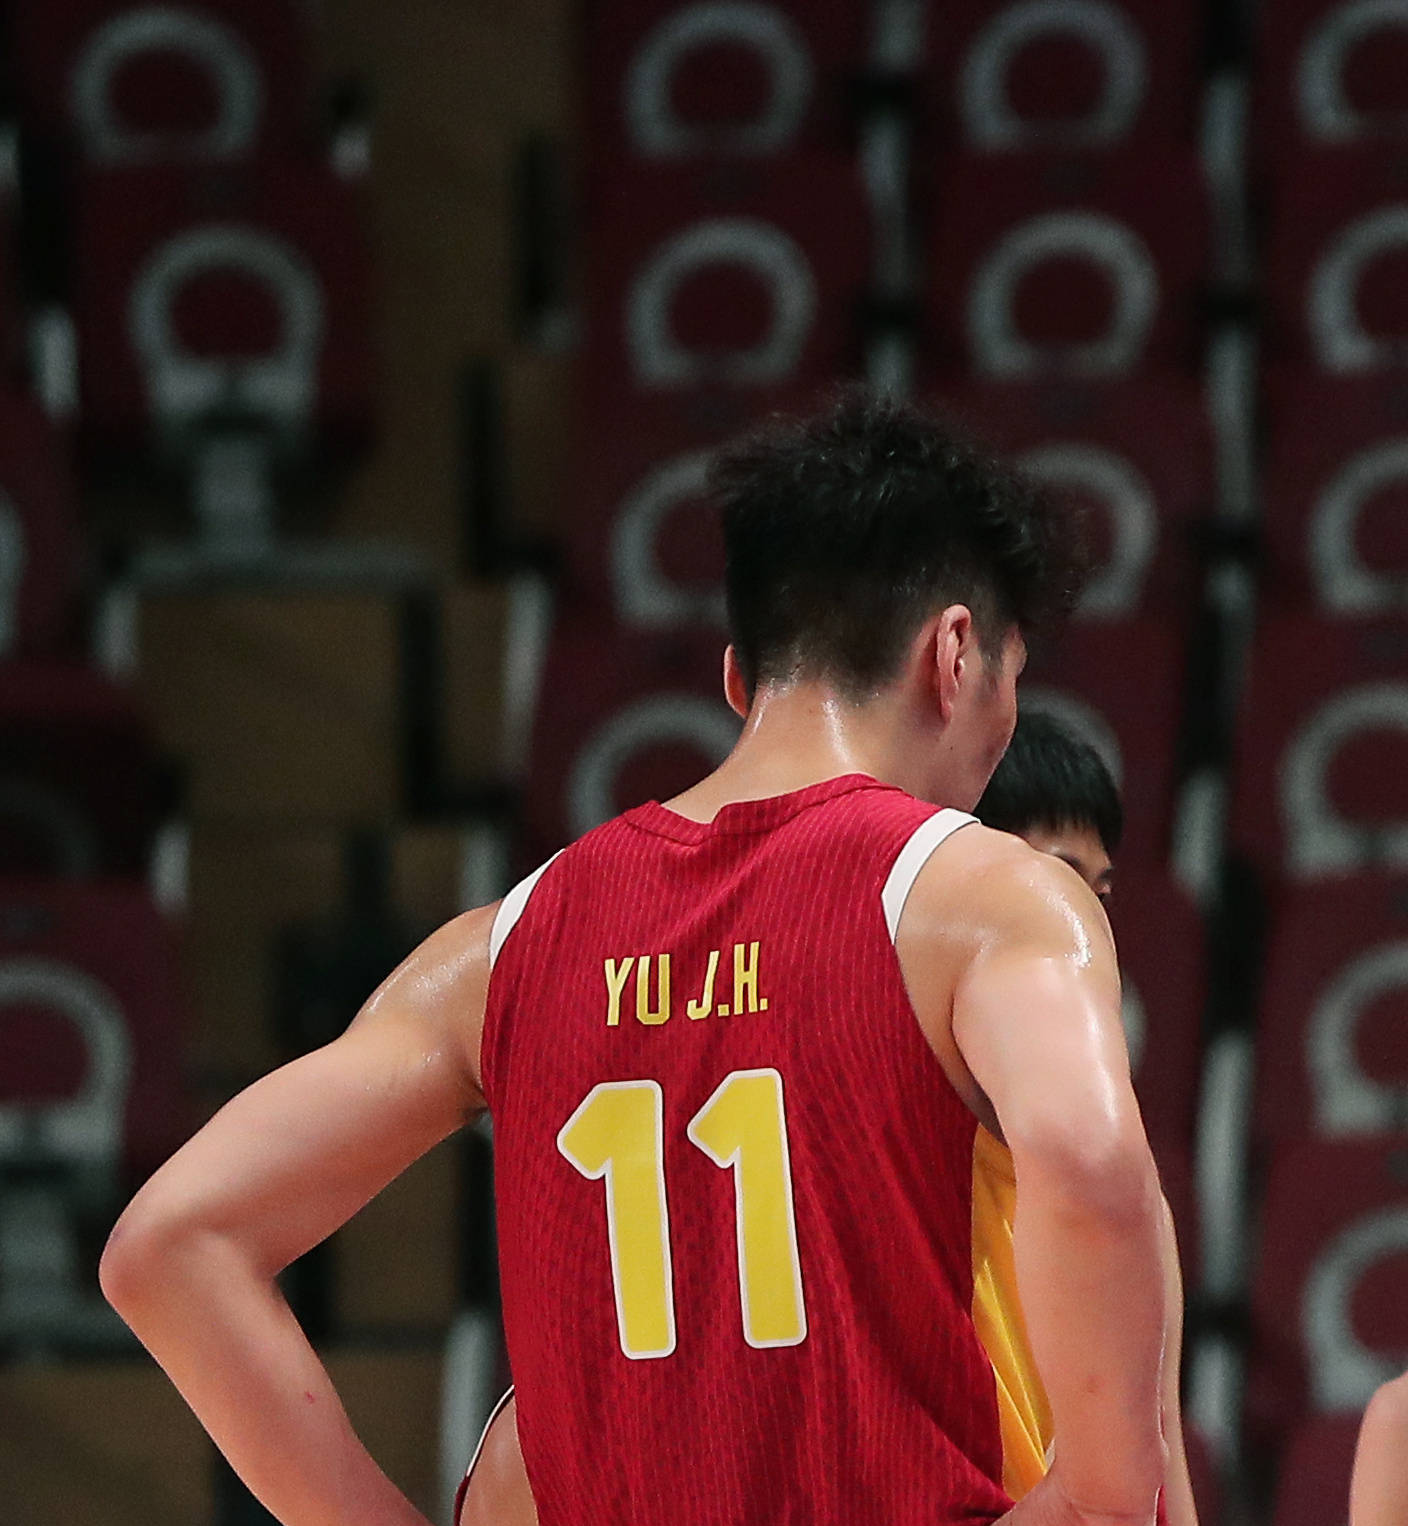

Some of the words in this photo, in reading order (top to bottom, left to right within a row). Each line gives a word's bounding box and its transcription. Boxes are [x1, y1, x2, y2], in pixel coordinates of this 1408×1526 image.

[604, 953, 671, 1026] YU
[687, 942, 768, 1021] J.H.
[557, 1068, 807, 1360] 11
